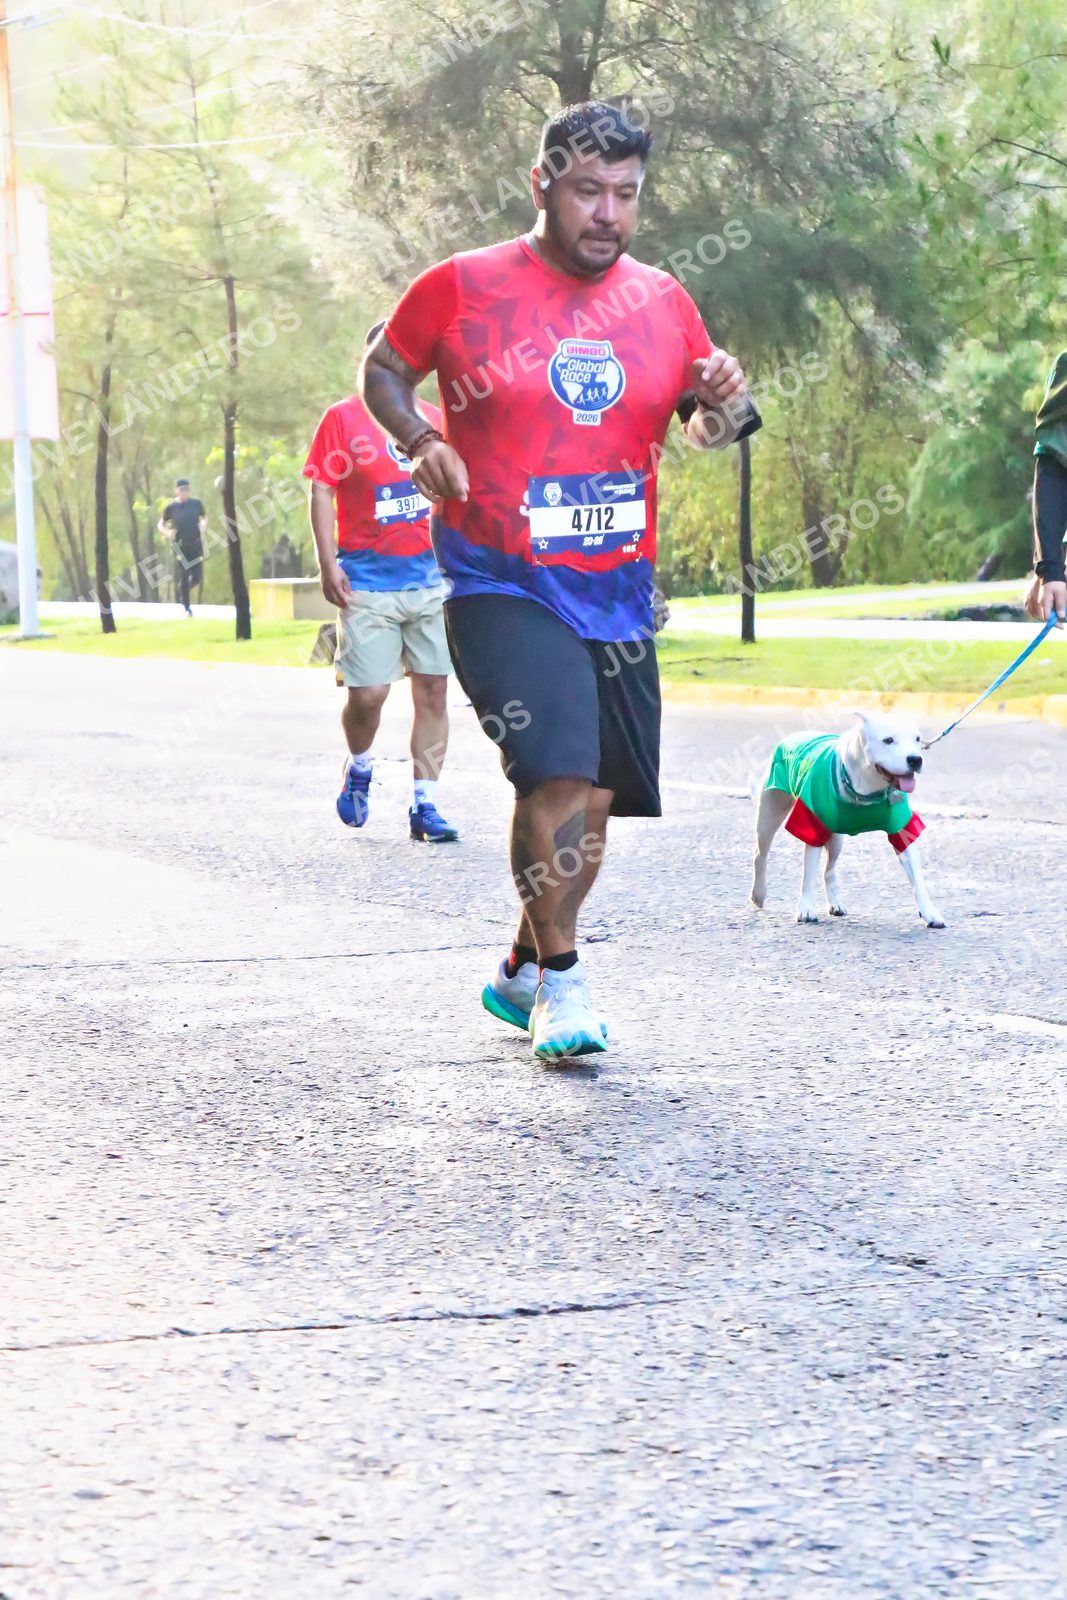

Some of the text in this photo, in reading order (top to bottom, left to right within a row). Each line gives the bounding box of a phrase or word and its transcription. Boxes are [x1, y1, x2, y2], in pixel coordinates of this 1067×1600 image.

[566, 346, 606, 356] BIMBO
[567, 359, 606, 374] Global
[560, 369, 591, 383] Race
[576, 413, 598, 423] 2026
[572, 506, 614, 532] 4712
